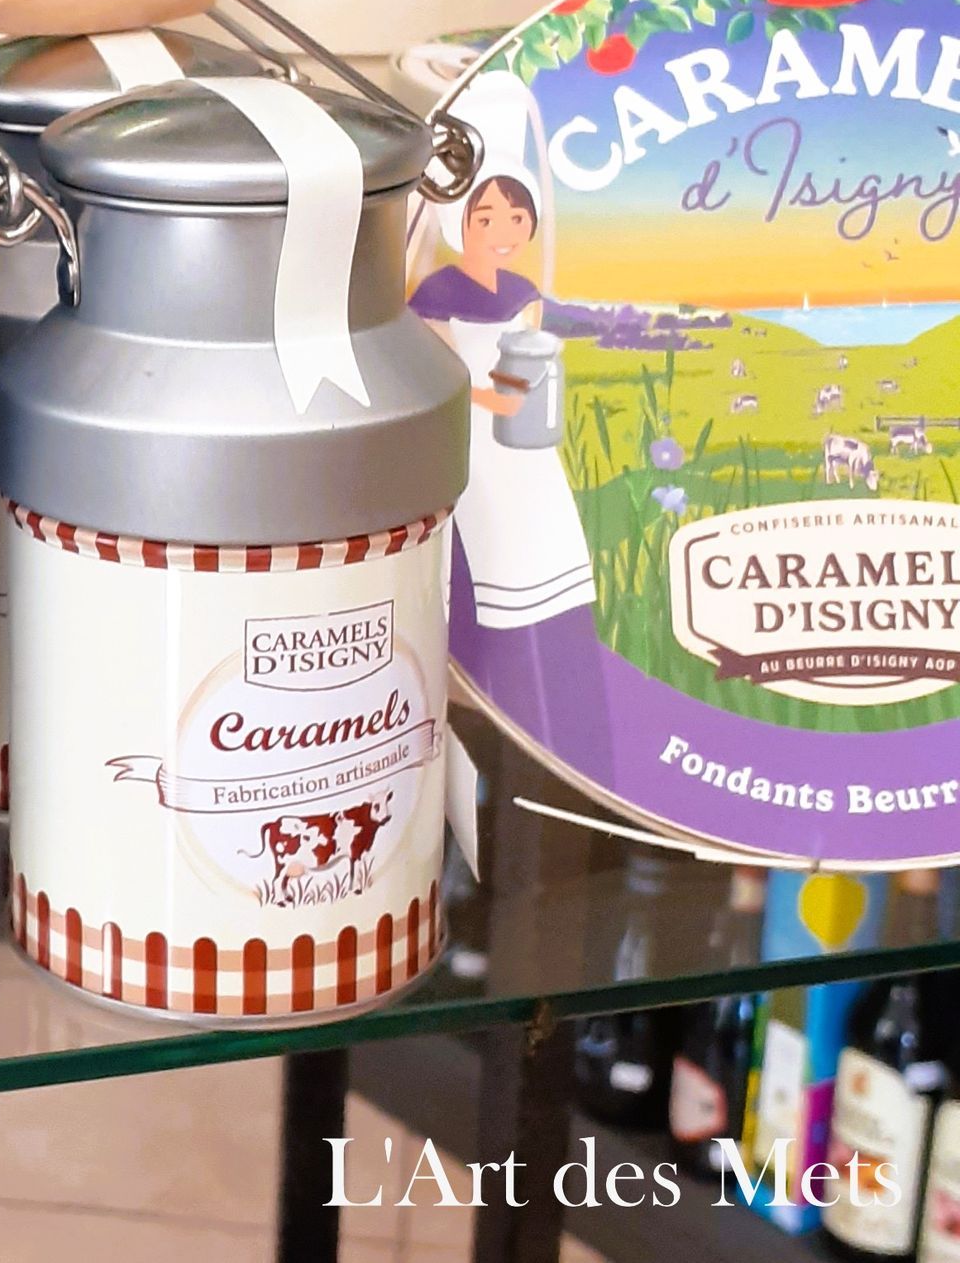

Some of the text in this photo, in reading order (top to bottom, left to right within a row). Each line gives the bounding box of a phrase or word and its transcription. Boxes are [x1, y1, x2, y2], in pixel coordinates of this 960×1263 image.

[730, 513, 845, 536] CONFISERIE
[251, 616, 389, 653] CARAMELS
[753, 599, 960, 634] D'ISIGNY
[252, 639, 389, 676] D'ISIGNY
[760, 654, 956, 674] AU BEURRE D'ISIGNY AOP
[209, 689, 411, 754] Caramels
[213, 743, 410, 806] Fabrication artisanale
[659, 735, 835, 813] Fondants
